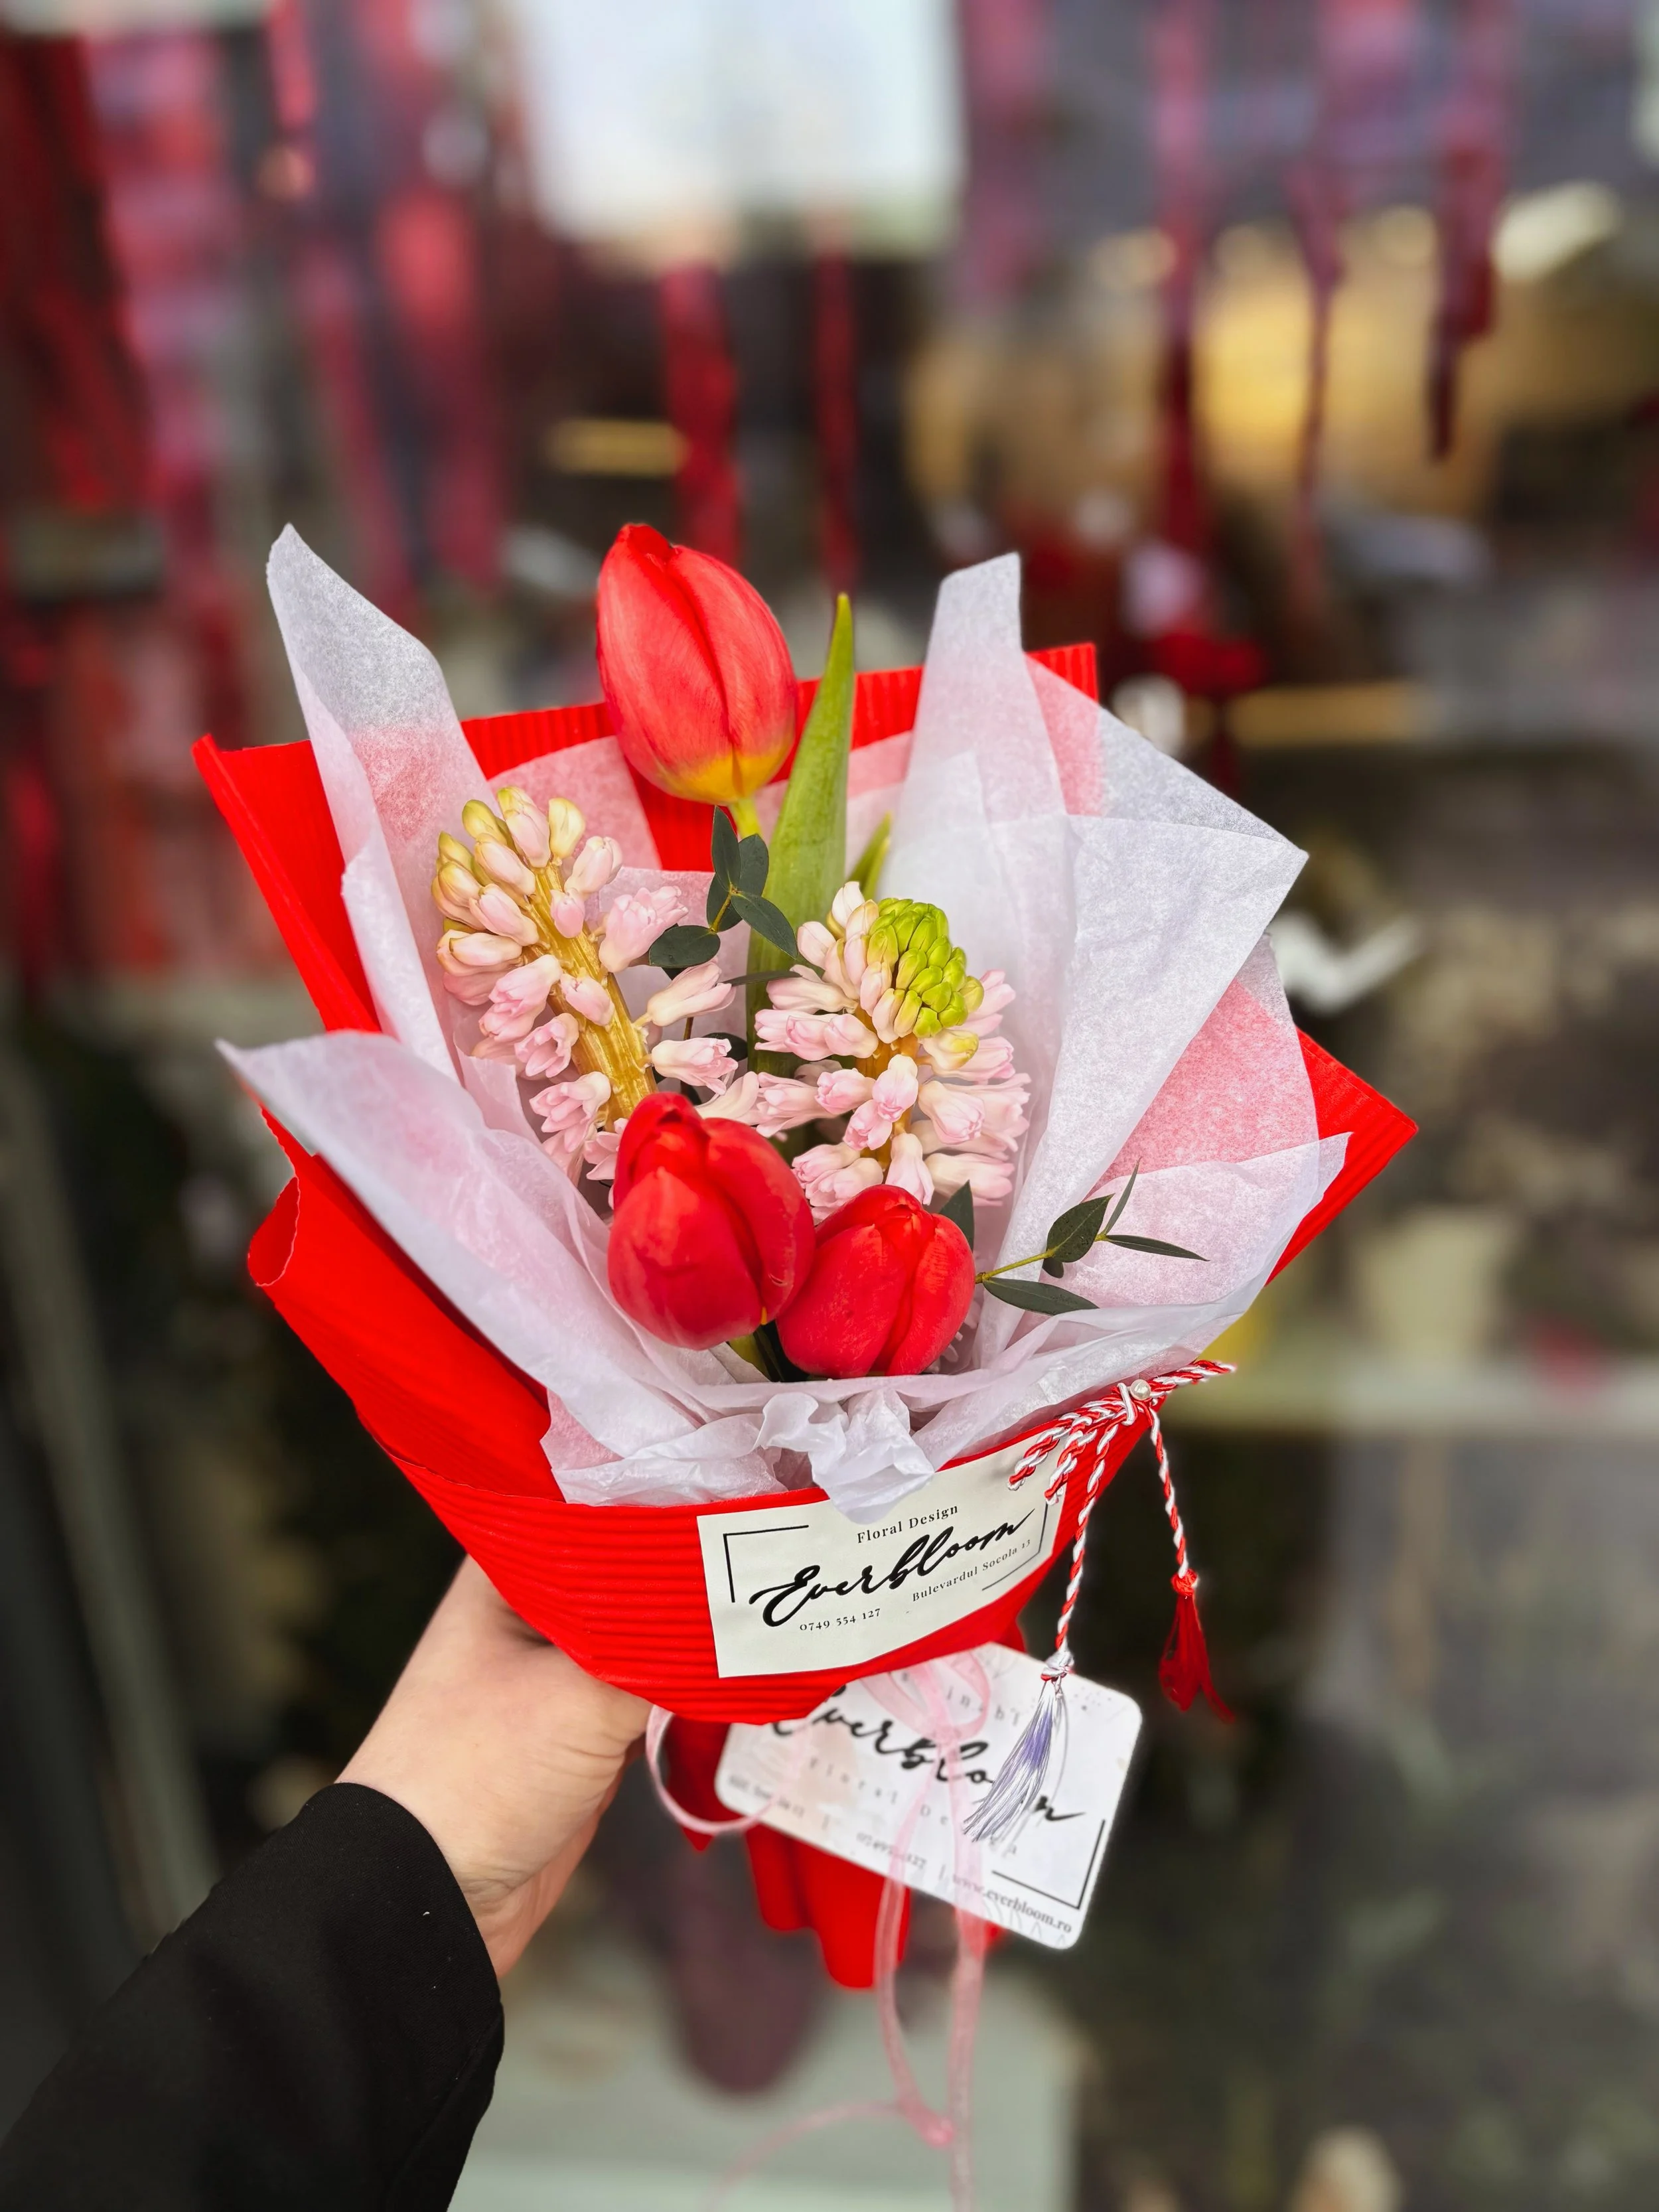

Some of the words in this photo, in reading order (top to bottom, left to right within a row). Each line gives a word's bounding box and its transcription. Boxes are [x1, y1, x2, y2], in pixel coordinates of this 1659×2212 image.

[857, 1520, 902, 1544] Floral
[908, 1505, 959, 1529] Design
[749, 1508, 1035, 1627] Everbloom
[912, 1566, 978, 1603] Bulevardul
[982, 1548, 1018, 1572] Socola
[1021, 1539, 1031, 1549] 13
[799, 1620, 831, 1632] 0749
[836, 1615, 857, 1627] 554
[863, 1607, 881, 1621] 127
